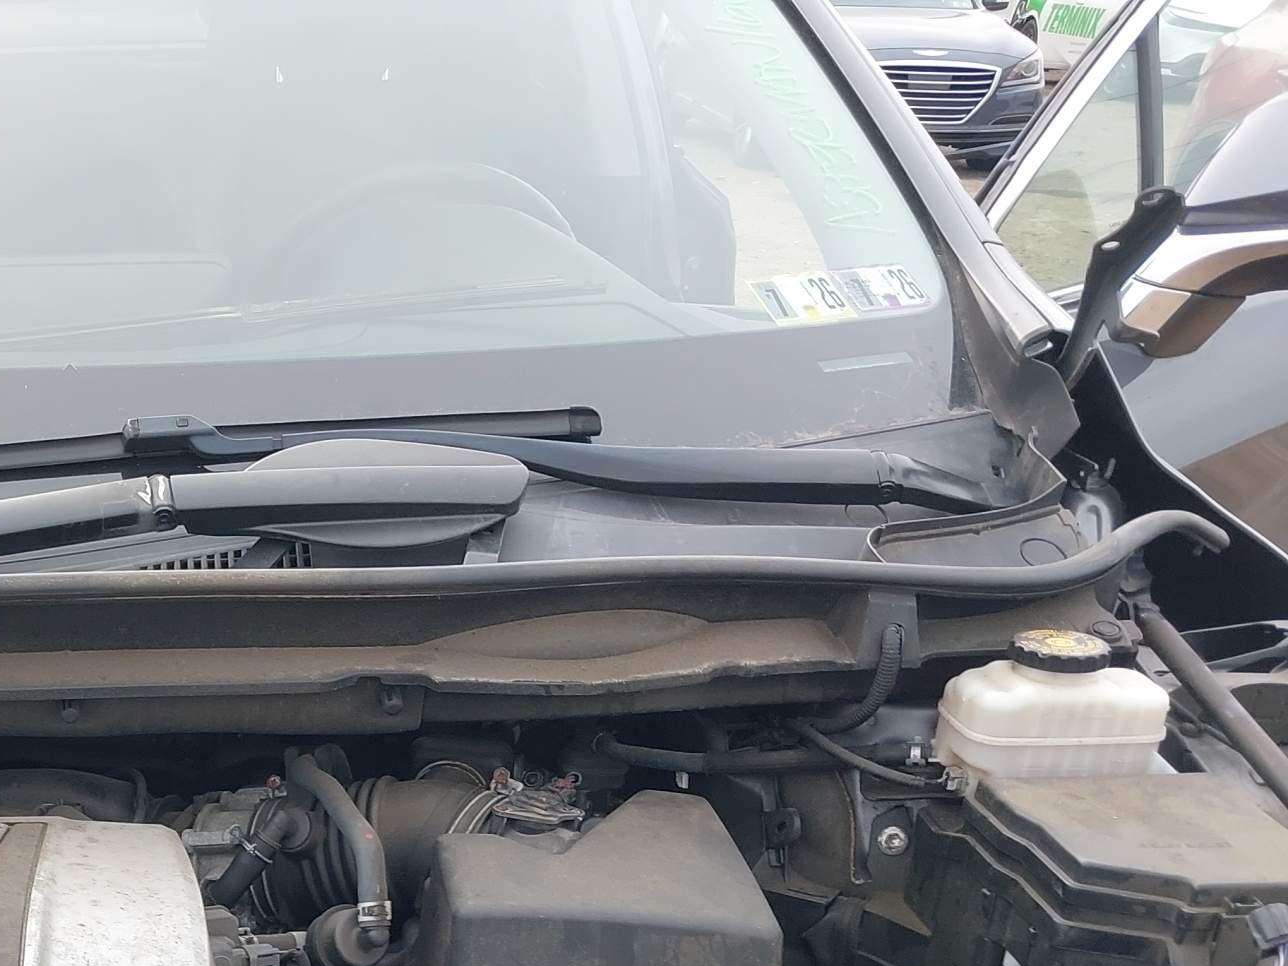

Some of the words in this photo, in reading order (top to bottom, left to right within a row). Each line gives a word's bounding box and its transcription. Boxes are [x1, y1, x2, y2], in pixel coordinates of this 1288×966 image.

[1042, 4, 1106, 39] TERMINIX
[764, 288, 789, 317] 7
[807, 277, 846, 310] 26
[887, 268, 925, 300] 26
